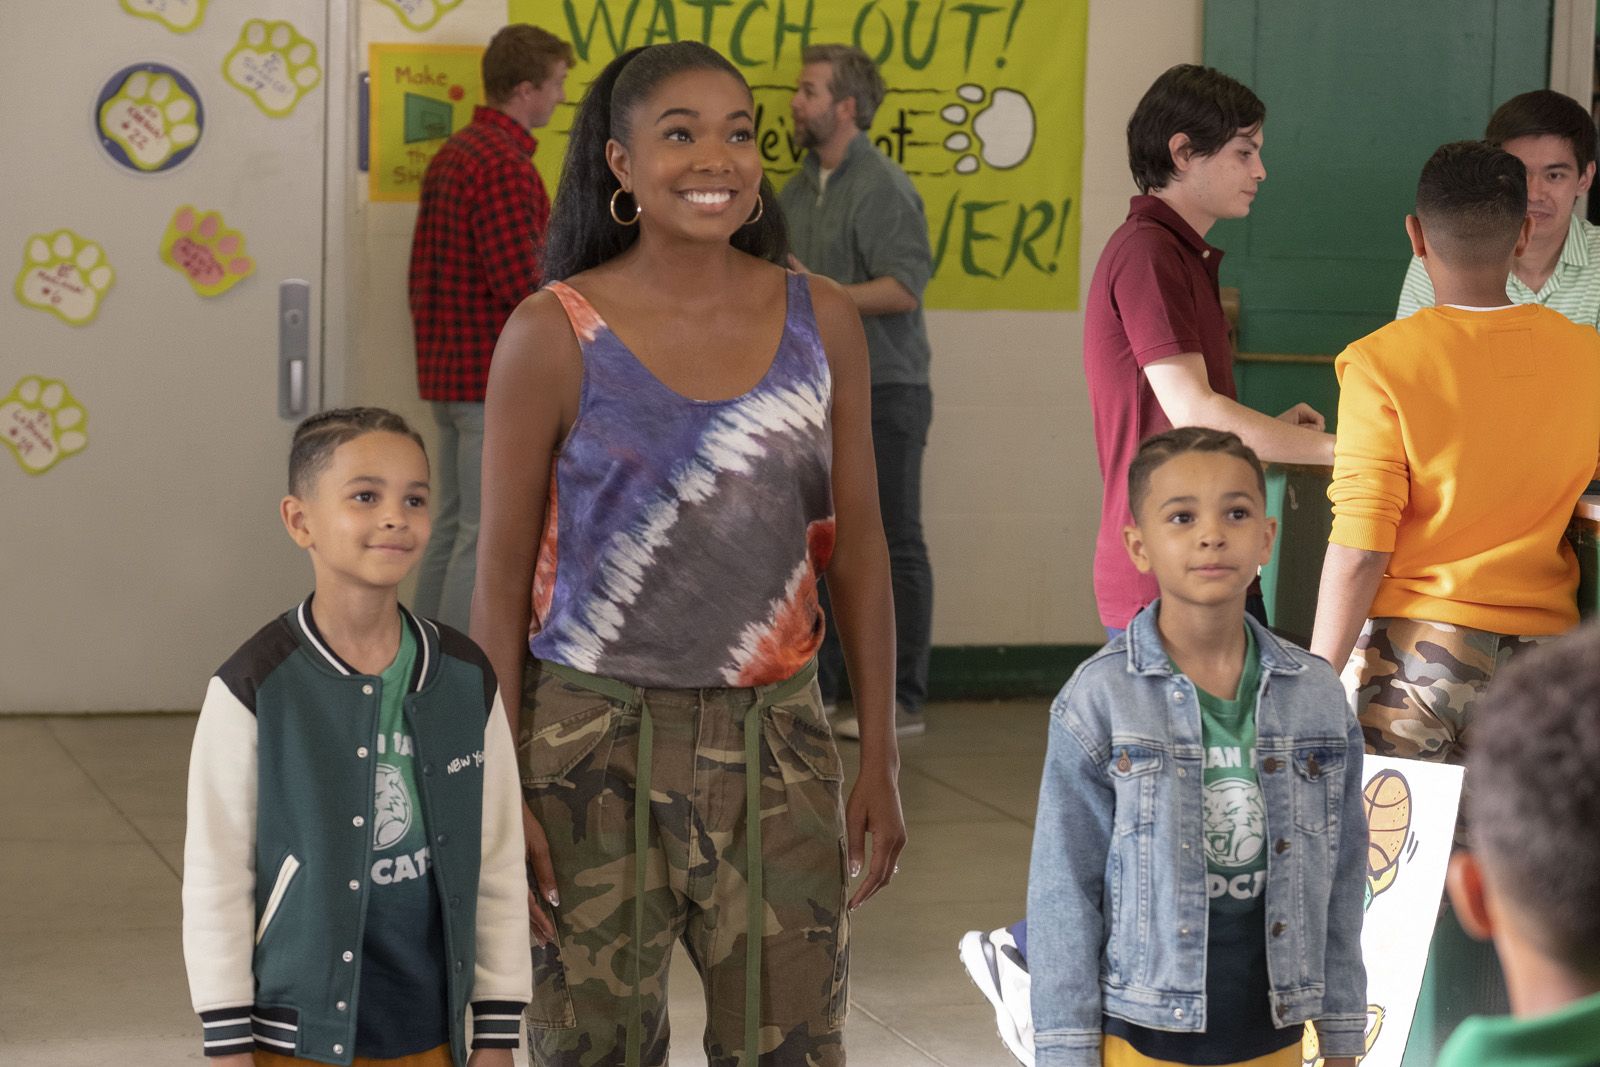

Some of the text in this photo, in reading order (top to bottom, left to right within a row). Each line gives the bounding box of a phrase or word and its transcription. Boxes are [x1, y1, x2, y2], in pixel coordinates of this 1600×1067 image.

[562, 0, 1025, 74] WATCH OUT!
[370, 847, 431, 885] CAT
